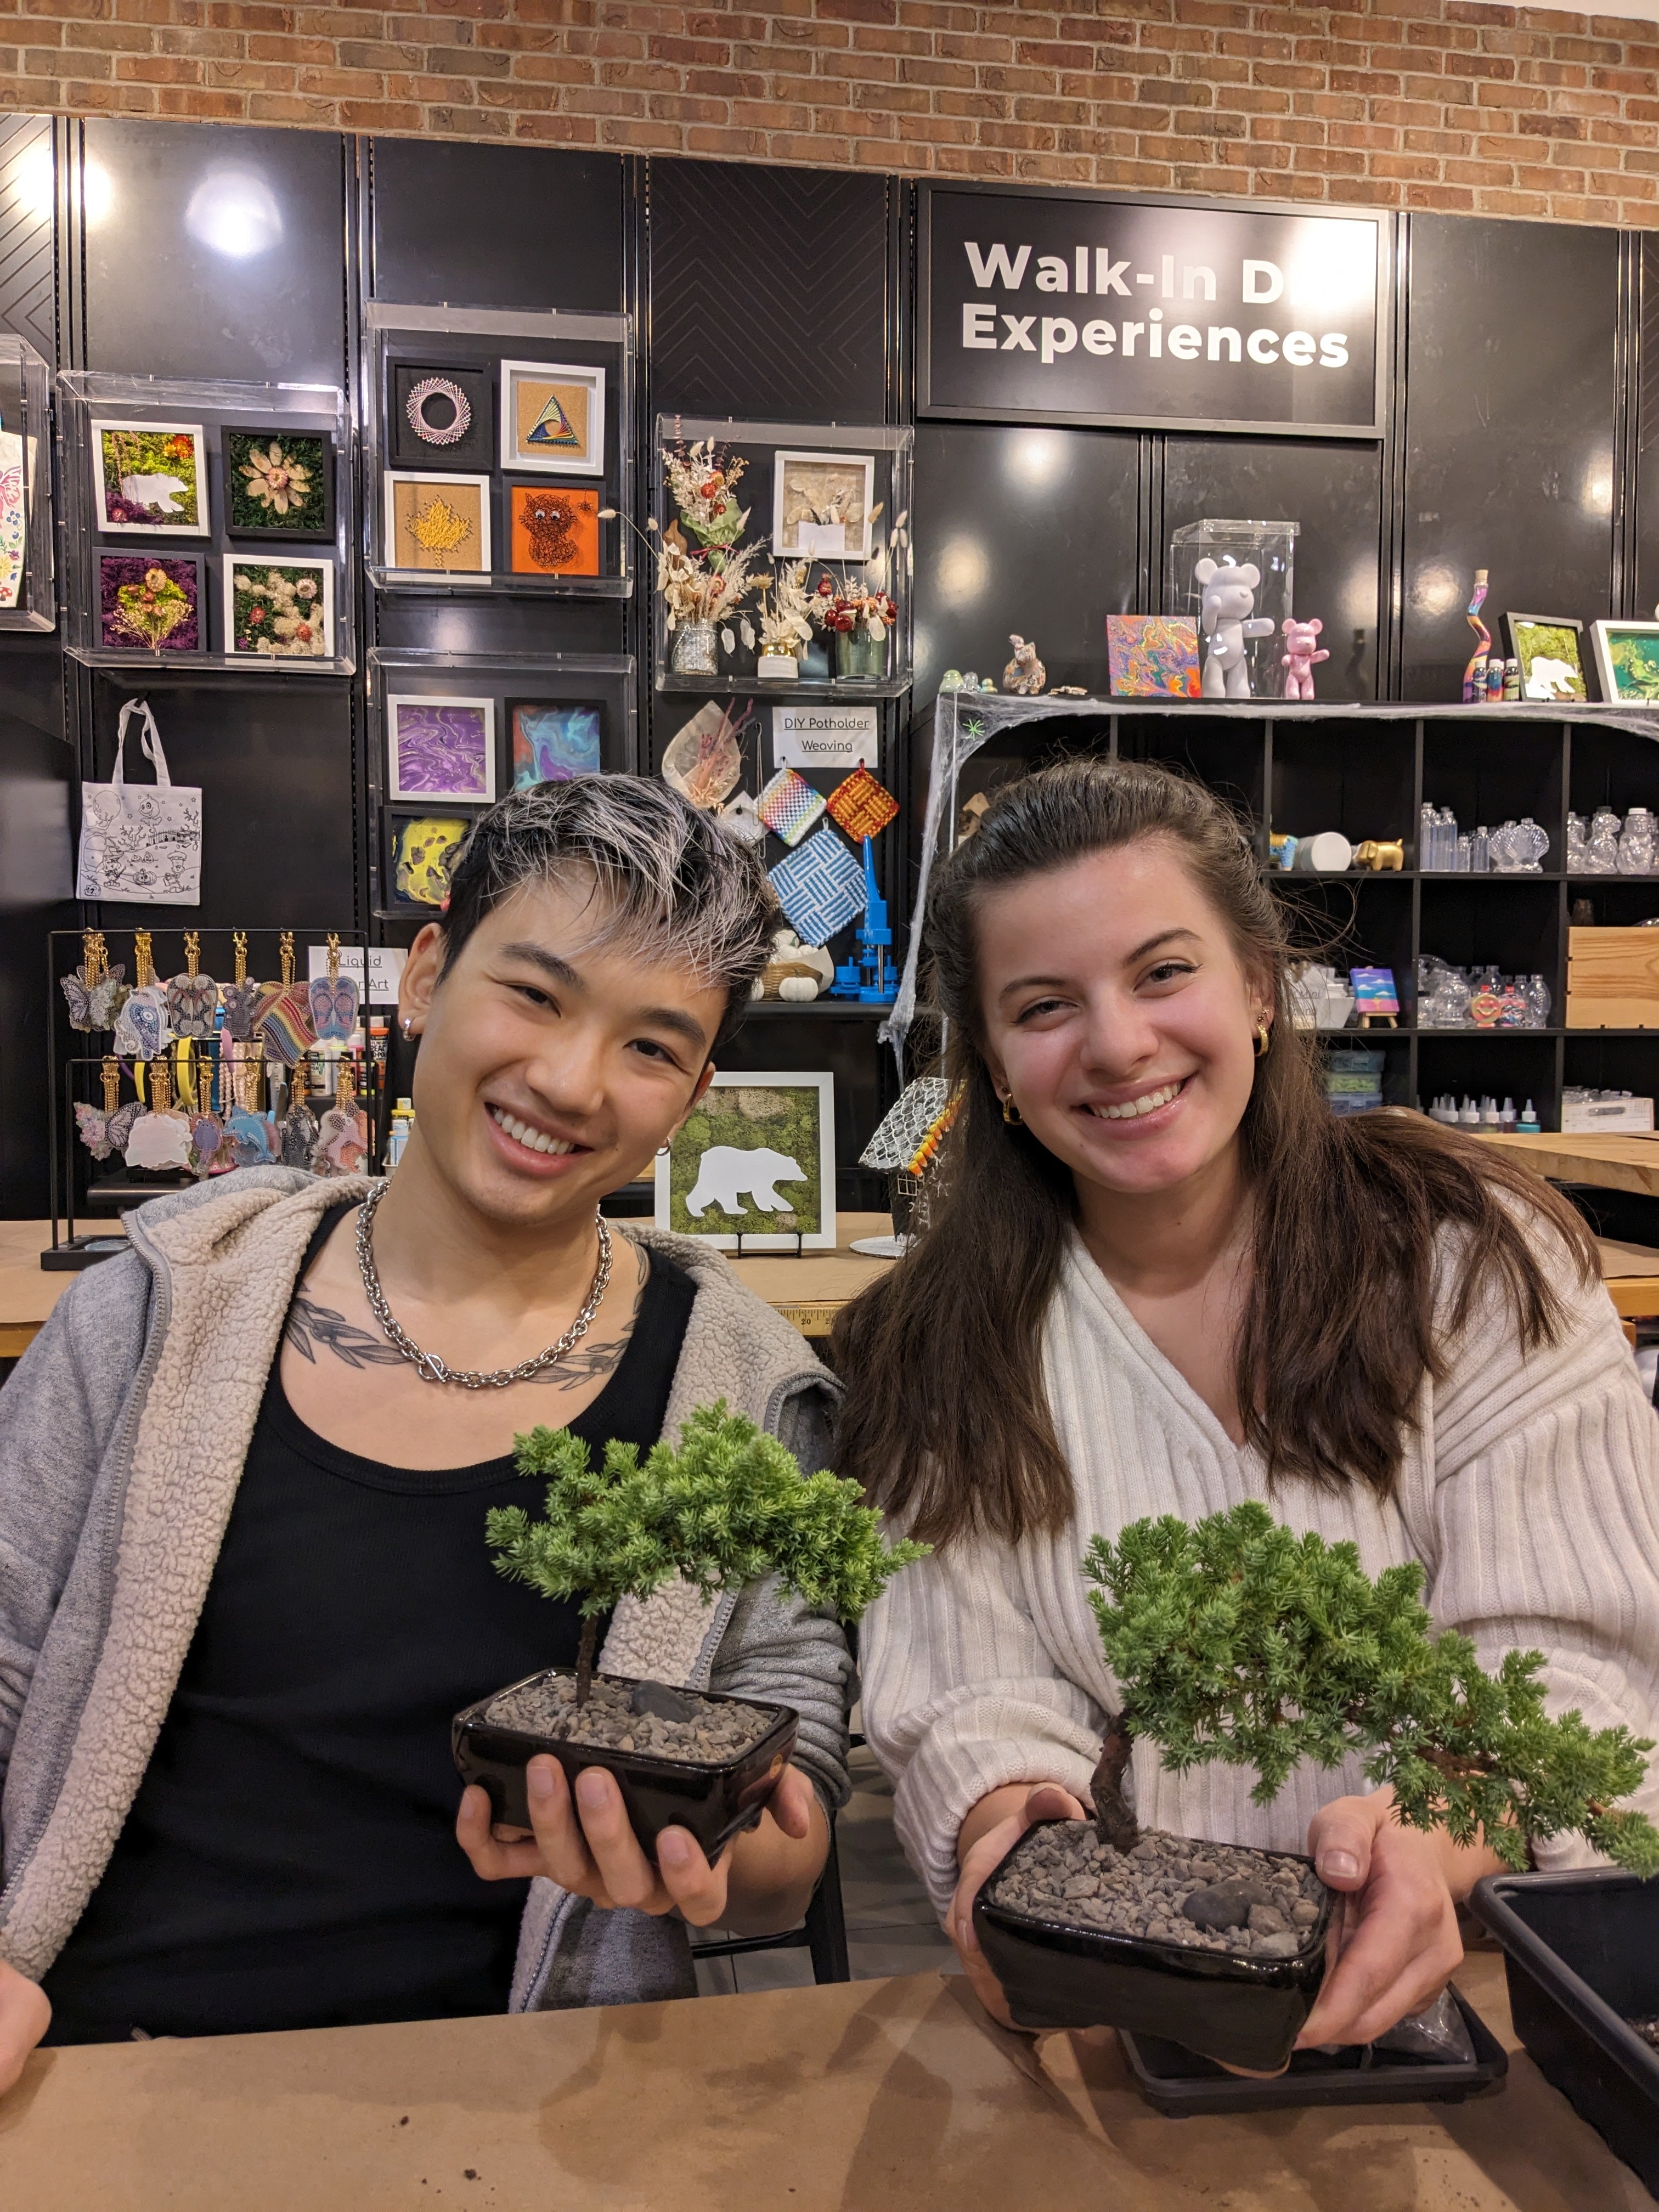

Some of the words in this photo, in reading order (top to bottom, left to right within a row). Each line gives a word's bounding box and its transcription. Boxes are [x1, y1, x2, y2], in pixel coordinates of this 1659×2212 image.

[963, 241, 1217, 302] Walk-In
[962, 302, 1349, 368] Experiences
[785, 718, 805, 729] DIY
[809, 718, 870, 729] Potholder
[802, 740, 853, 753] Weaving
